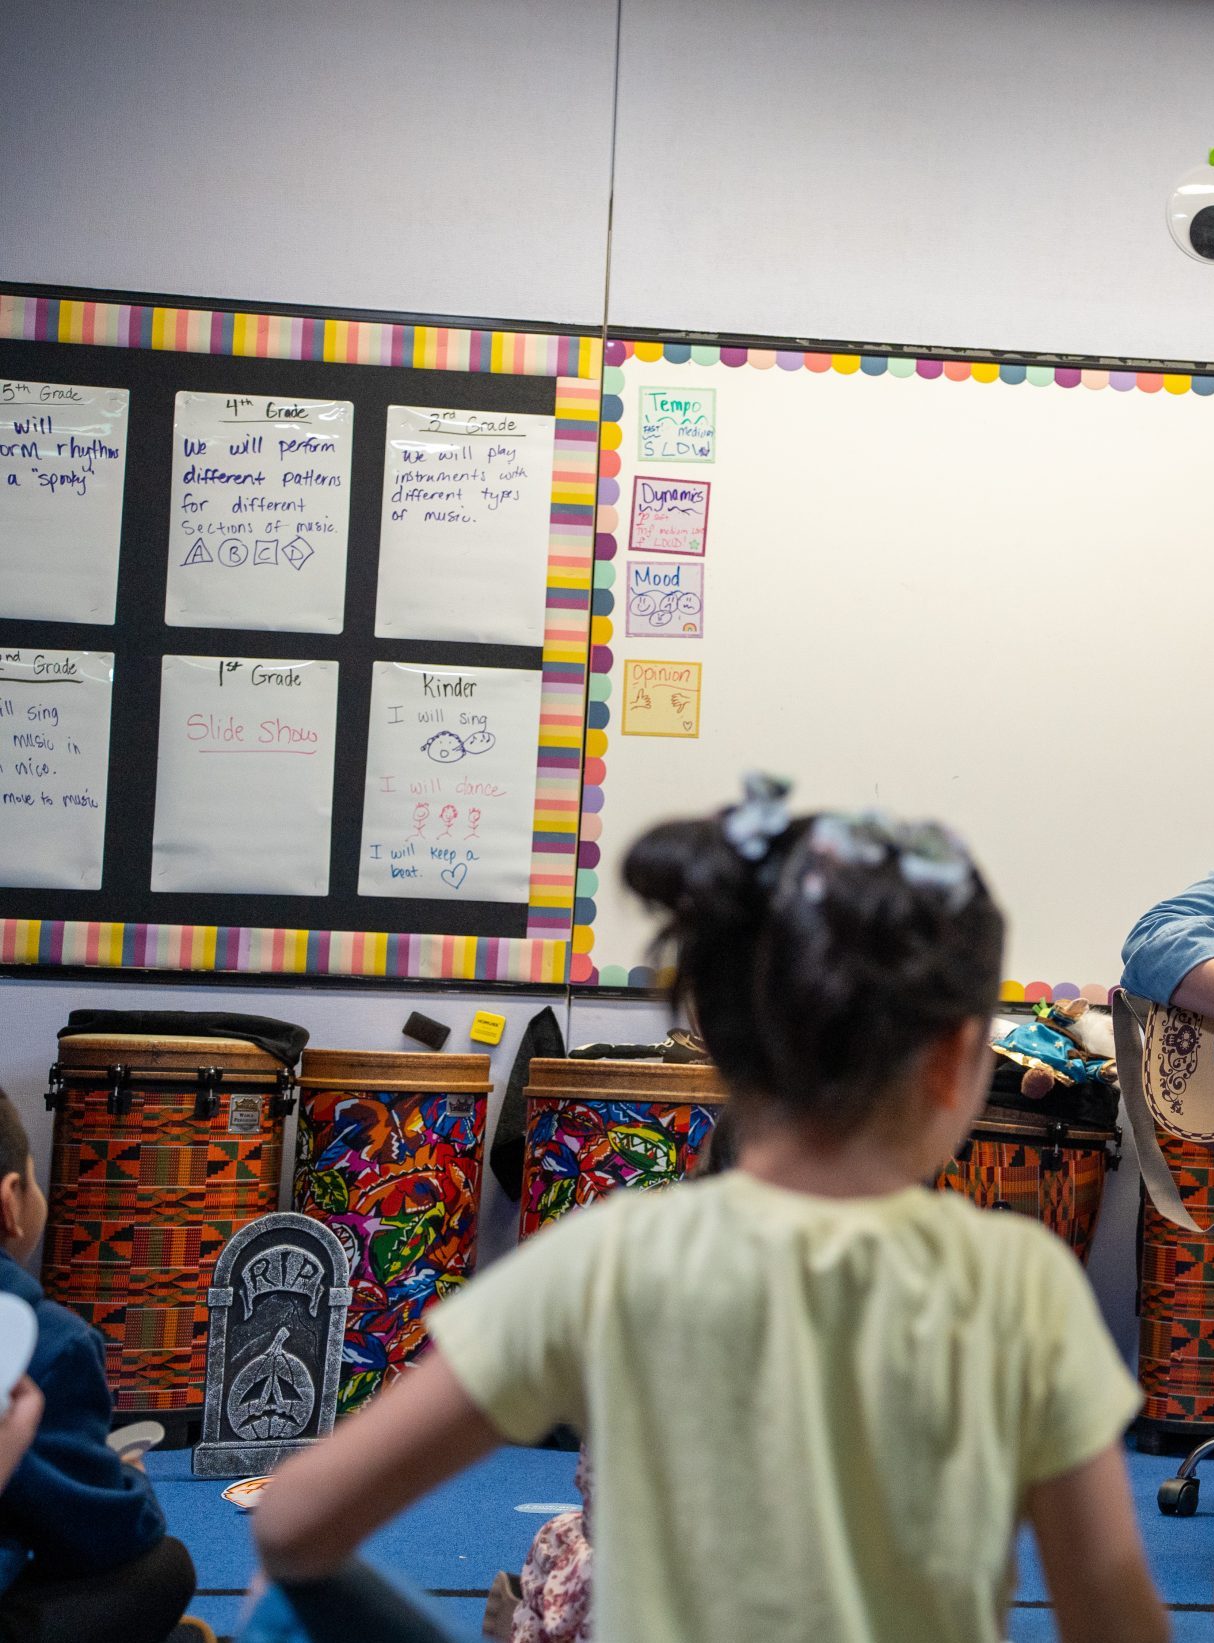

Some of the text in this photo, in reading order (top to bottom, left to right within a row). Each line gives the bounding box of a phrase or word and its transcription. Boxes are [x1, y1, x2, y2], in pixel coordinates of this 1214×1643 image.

[2, 383, 82, 402] 5th Grade
[226, 398, 310, 419] 4th Grade
[646, 392, 702, 417] Tempo
[14, 415, 52, 435] will
[427, 411, 518, 435] 3rd Grade
[57, 436, 119, 473] rhythms
[184, 434, 336, 461] We will perform
[402, 444, 516, 464] We will play
[8, 473, 21, 486] a
[183, 464, 342, 488] different patterns
[395, 466, 529, 485] instruments with
[181, 493, 306, 514] for different
[391, 485, 520, 510] different types
[391, 504, 477, 523] of music.
[265, 520, 289, 535] of
[296, 516, 338, 535] music.
[192, 544, 304, 564] A B C D
[635, 566, 680, 588] Mood
[33, 654, 77, 675] Grade
[219, 660, 302, 686] 1st Grade
[423, 673, 478, 698] Kinder
[632, 664, 691, 688] Opinion
[27, 704, 59, 727] sing
[387, 705, 488, 733] I will sing
[187, 713, 244, 742] Slide
[14, 733, 81, 755] music in
[380, 775, 507, 797] I will dance
[3, 788, 98, 808] move to music
[369, 844, 382, 860] I
[391, 842, 415, 860] will
[466, 849, 480, 861] a
[390, 864, 423, 879] beat.
[247, 1250, 320, 1292] RIP
